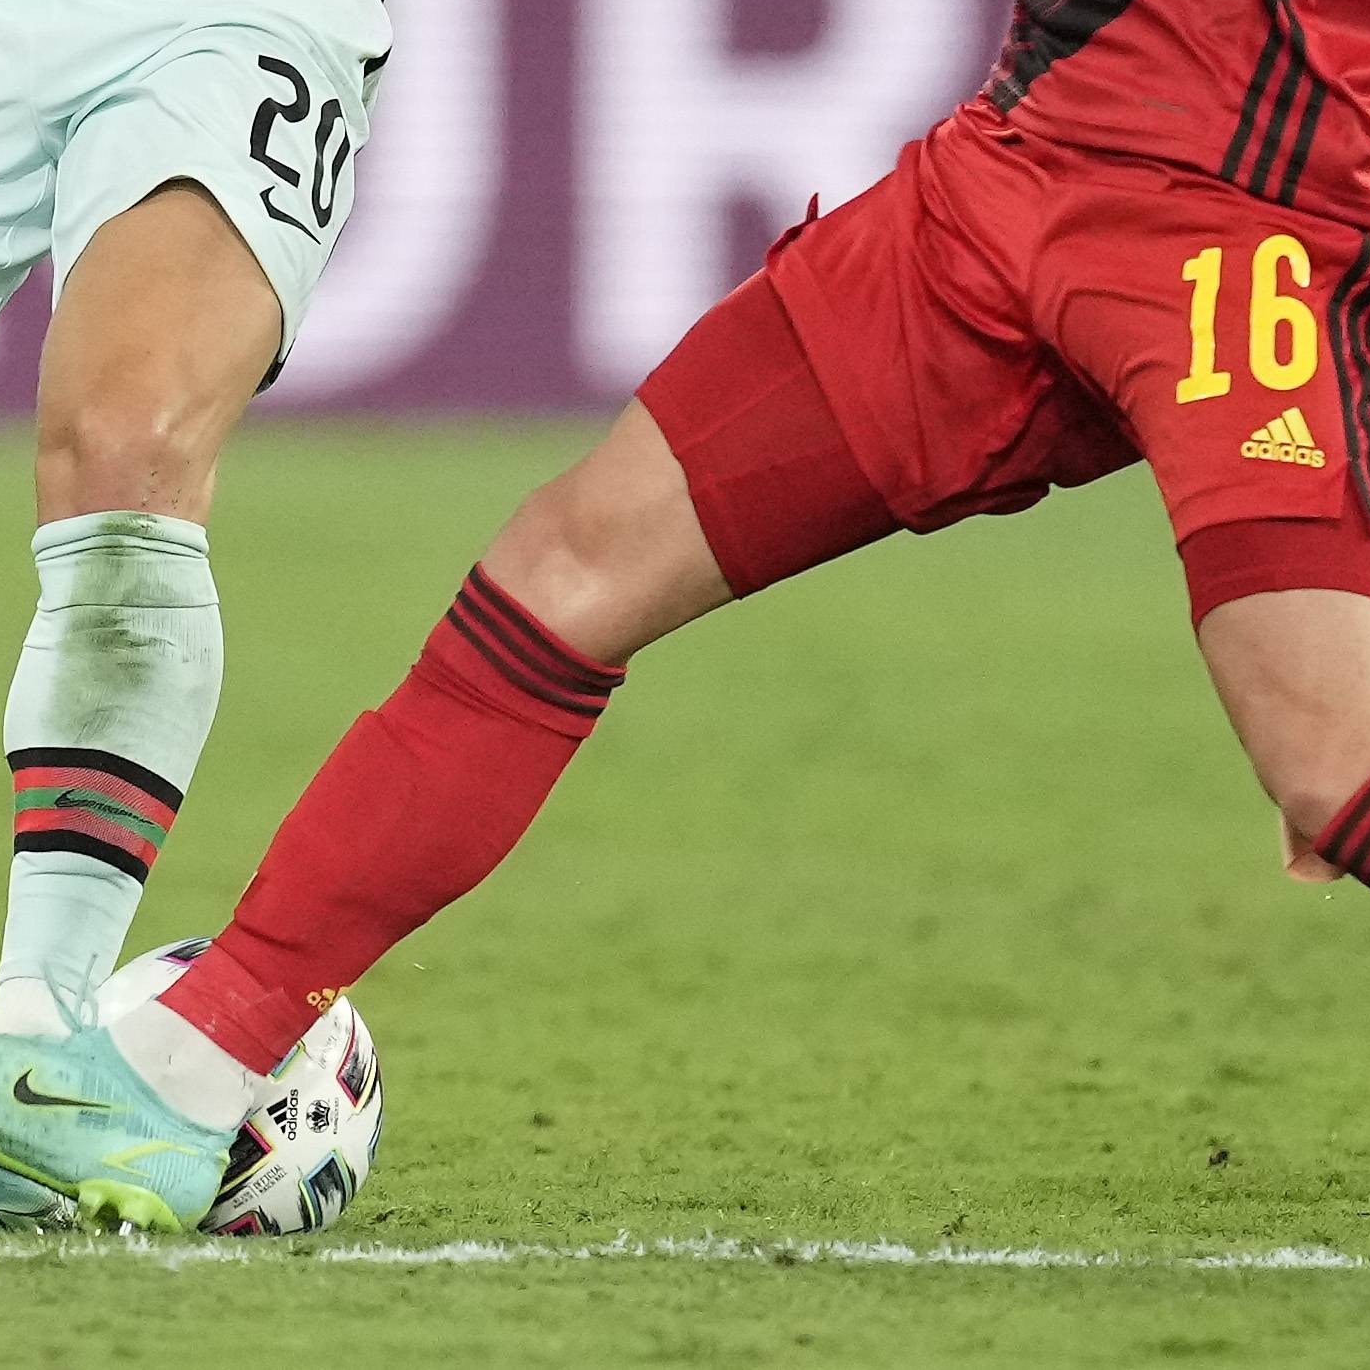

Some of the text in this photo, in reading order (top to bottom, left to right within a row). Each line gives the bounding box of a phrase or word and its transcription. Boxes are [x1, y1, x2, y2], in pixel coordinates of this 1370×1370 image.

[249, 54, 352, 229] 20
[1175, 234, 1318, 404] 16
[1240, 440, 1326, 468] adidas
[287, 1088, 299, 1141] adidas
